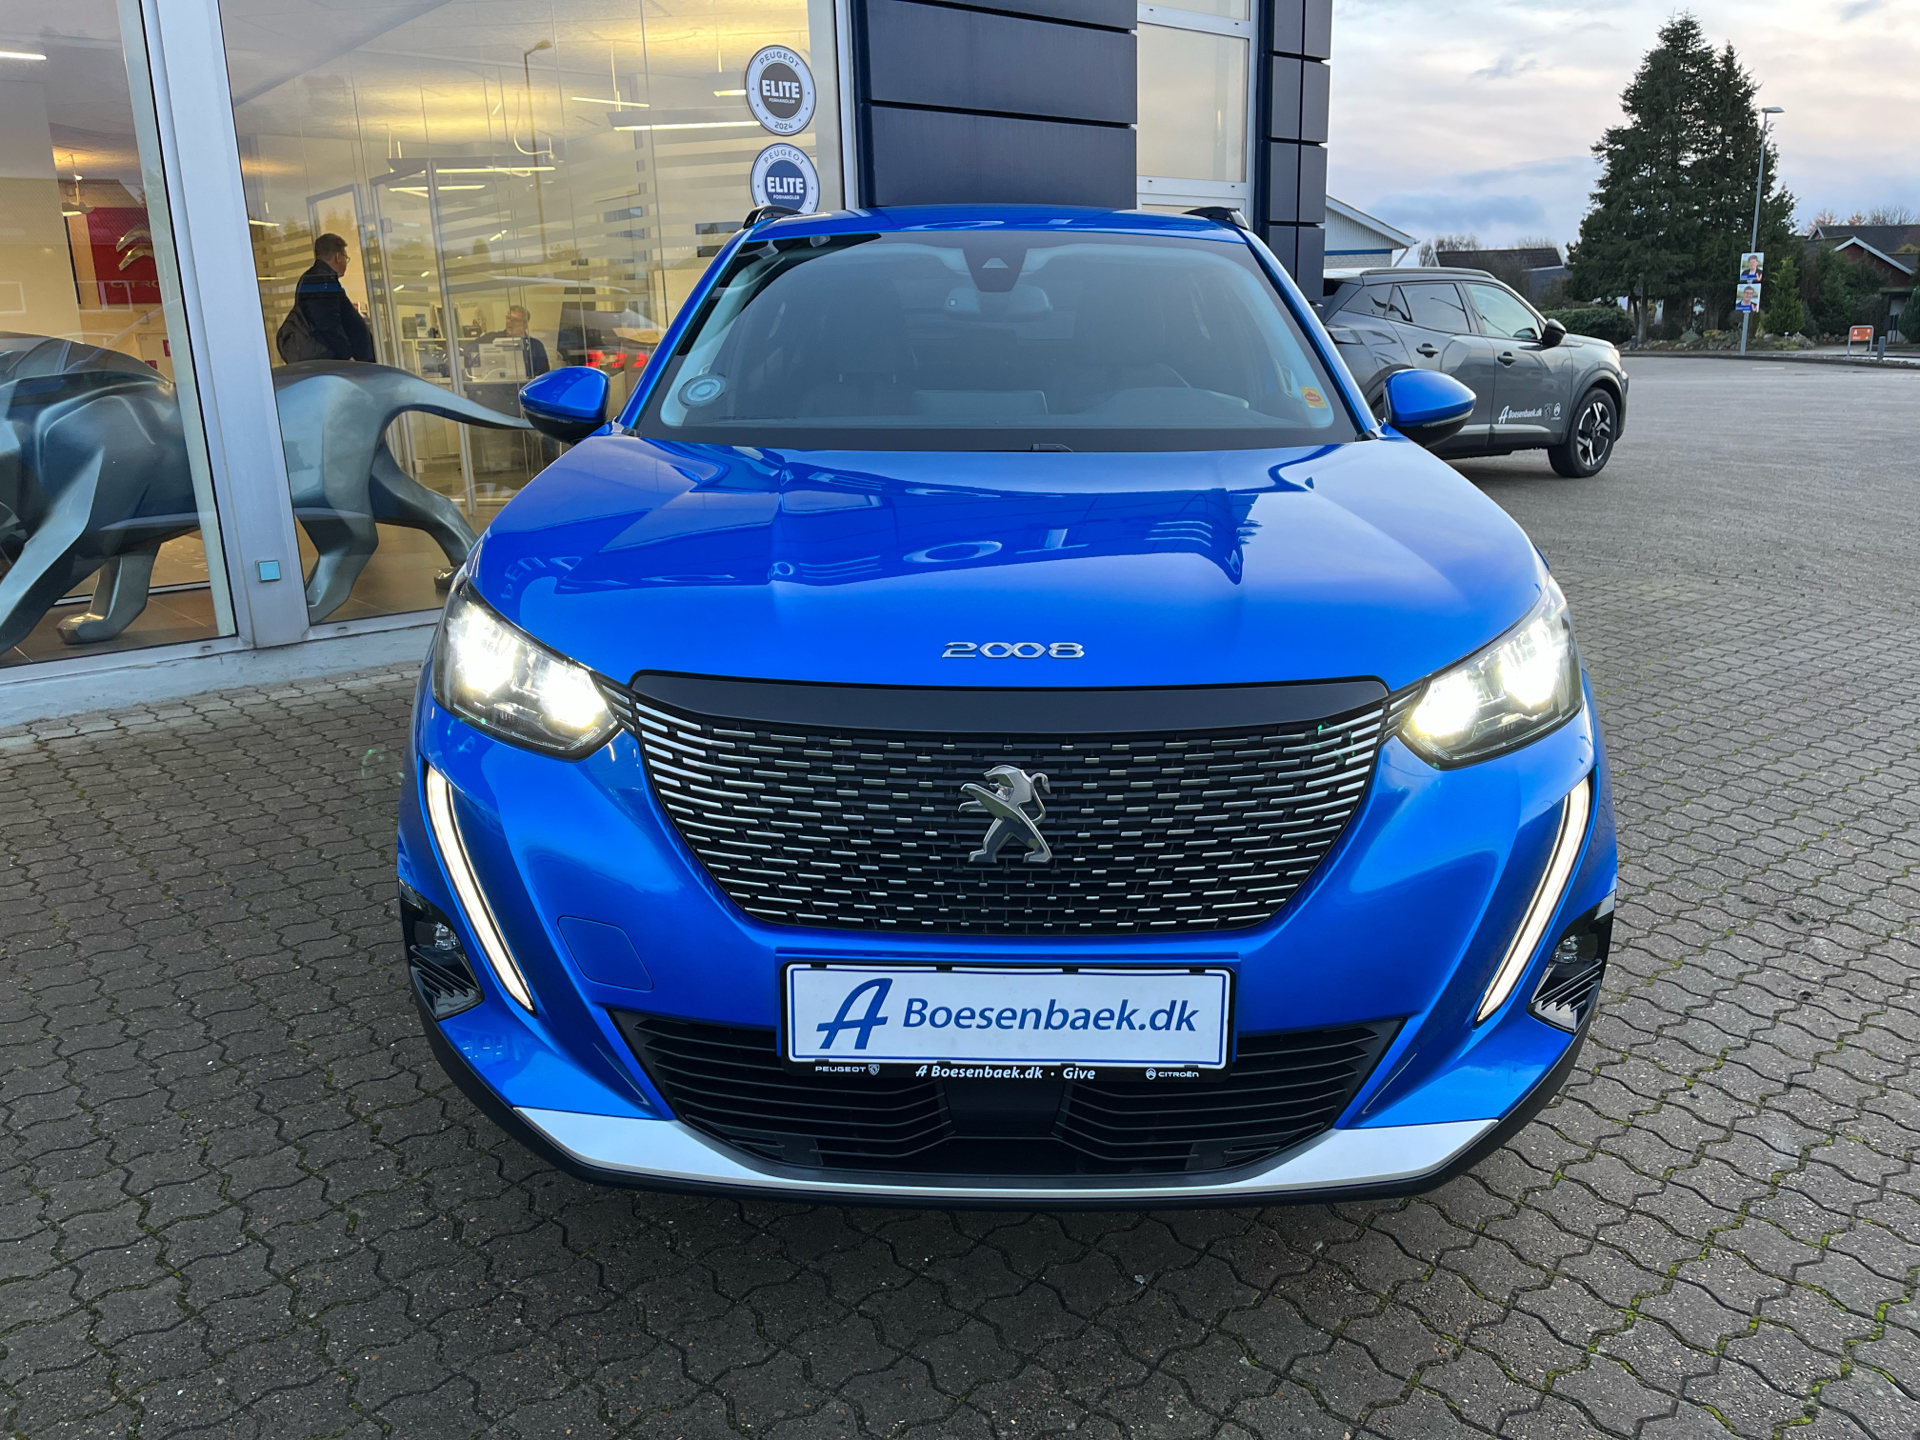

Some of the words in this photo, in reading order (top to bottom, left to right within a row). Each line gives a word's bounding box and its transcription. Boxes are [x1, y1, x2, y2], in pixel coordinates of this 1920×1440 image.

[759, 51, 800, 67] PEUGEOT
[761, 80, 800, 98] ELITE
[774, 121, 793, 130] 2024
[763, 149, 805, 165] PEUGEOT
[766, 177, 804, 194] ELITE
[941, 641, 1085, 658] 2008
[815, 977, 894, 1050] A
[902, 998, 1200, 1032] Boesenbaek.dk
[814, 1065, 867, 1073] PEUGEOT
[931, 1065, 1043, 1079] Boesenbaek.dk
[1062, 1067, 1096, 1080] Give
